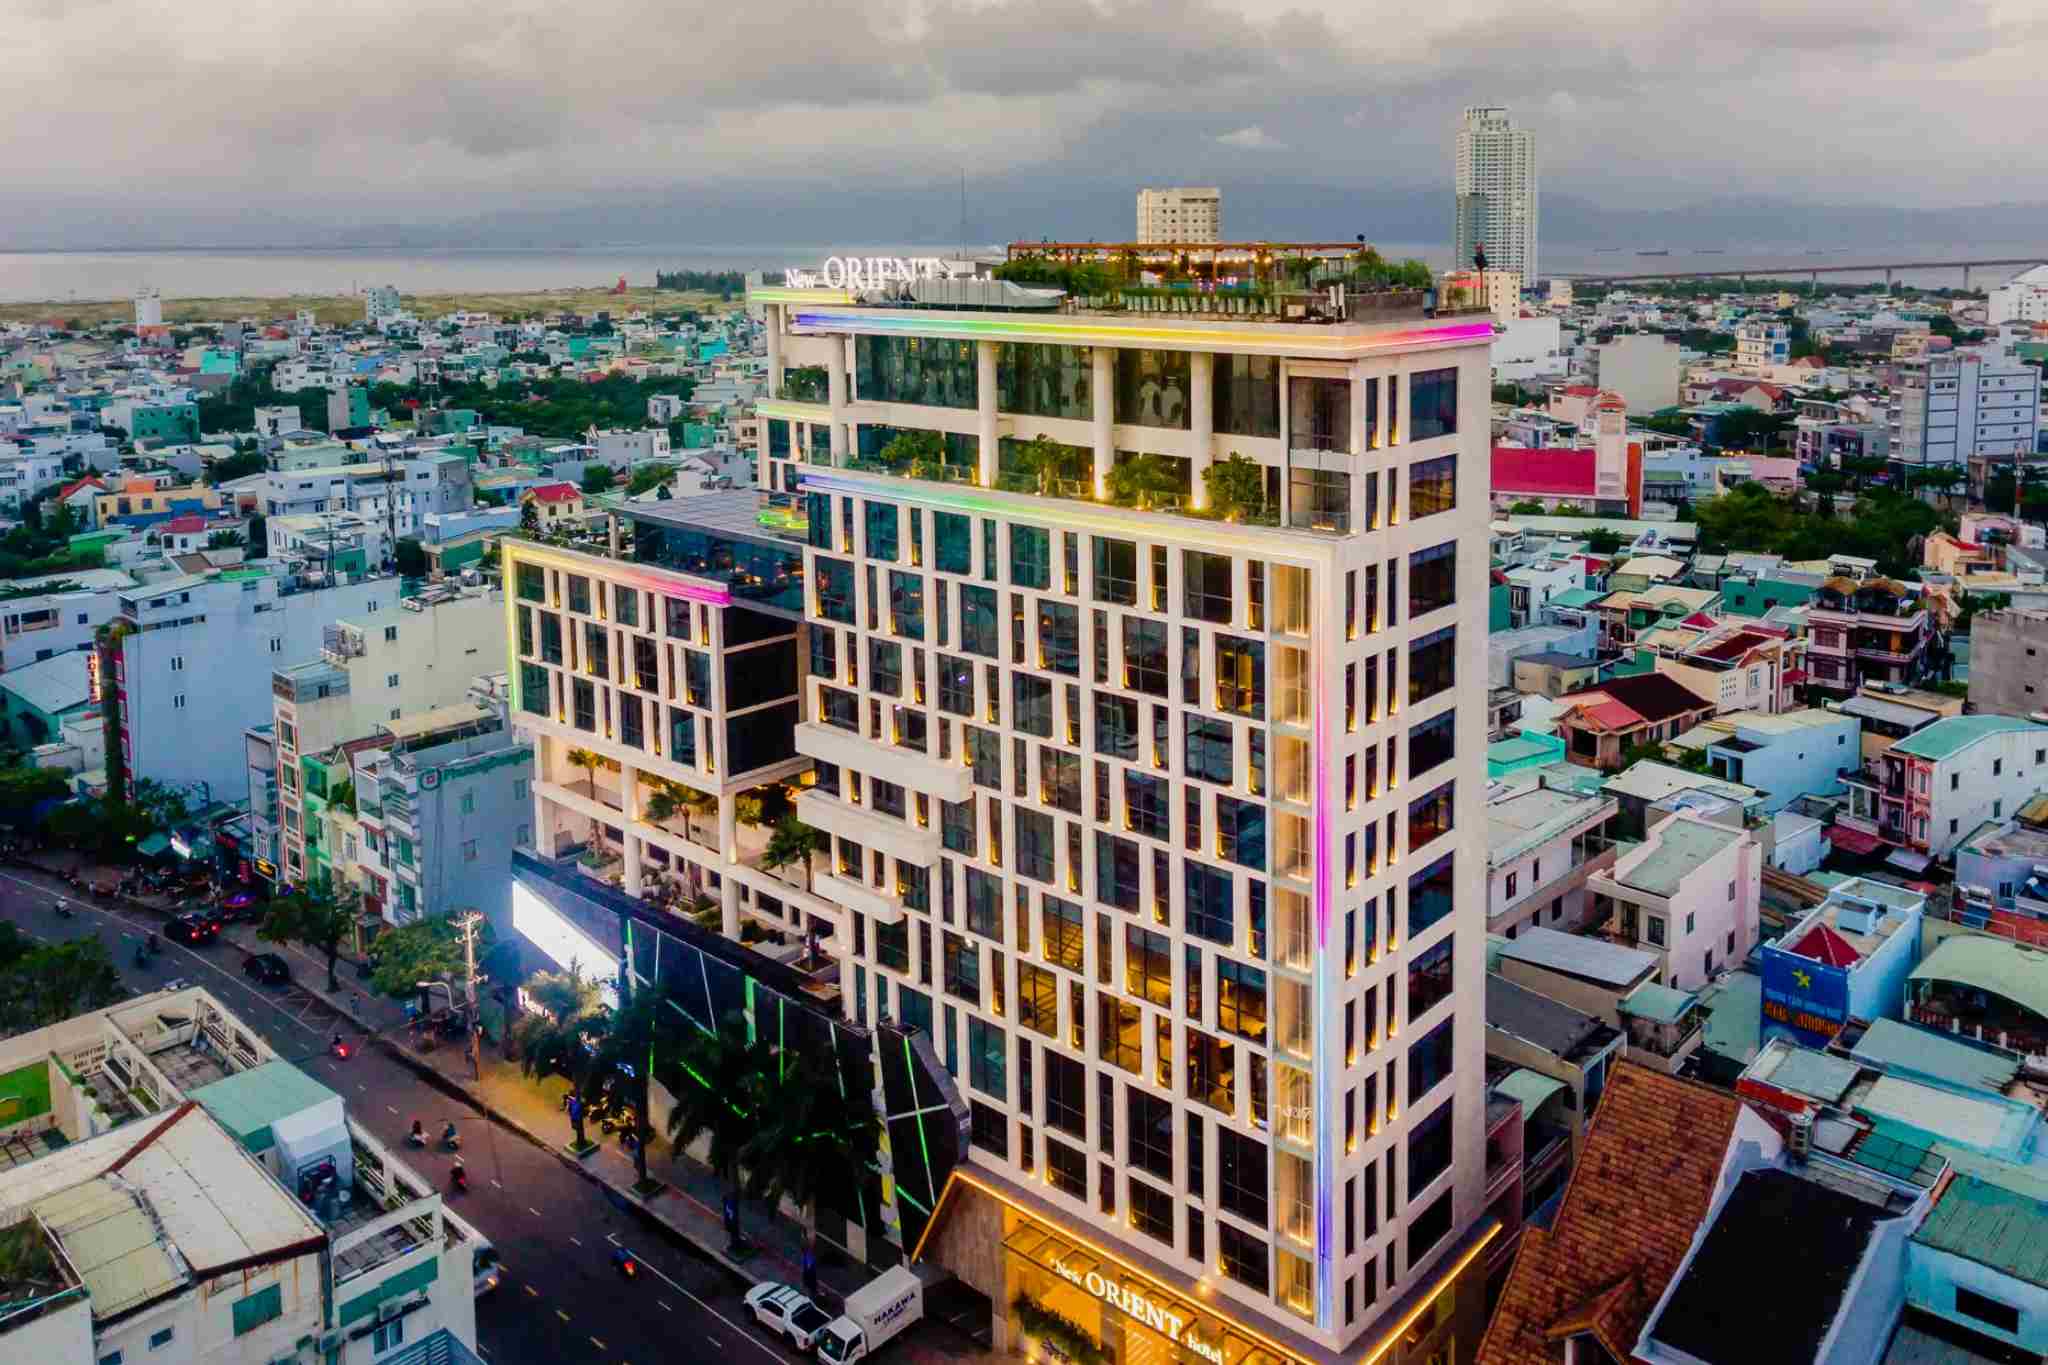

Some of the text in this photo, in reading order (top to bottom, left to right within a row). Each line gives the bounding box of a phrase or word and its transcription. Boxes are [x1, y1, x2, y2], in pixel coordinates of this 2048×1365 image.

[784, 268, 817, 289] New
[823, 256, 942, 291] ORIENT
[1055, 1259, 1083, 1286] New
[1086, 1271, 1183, 1341] ORIENT
